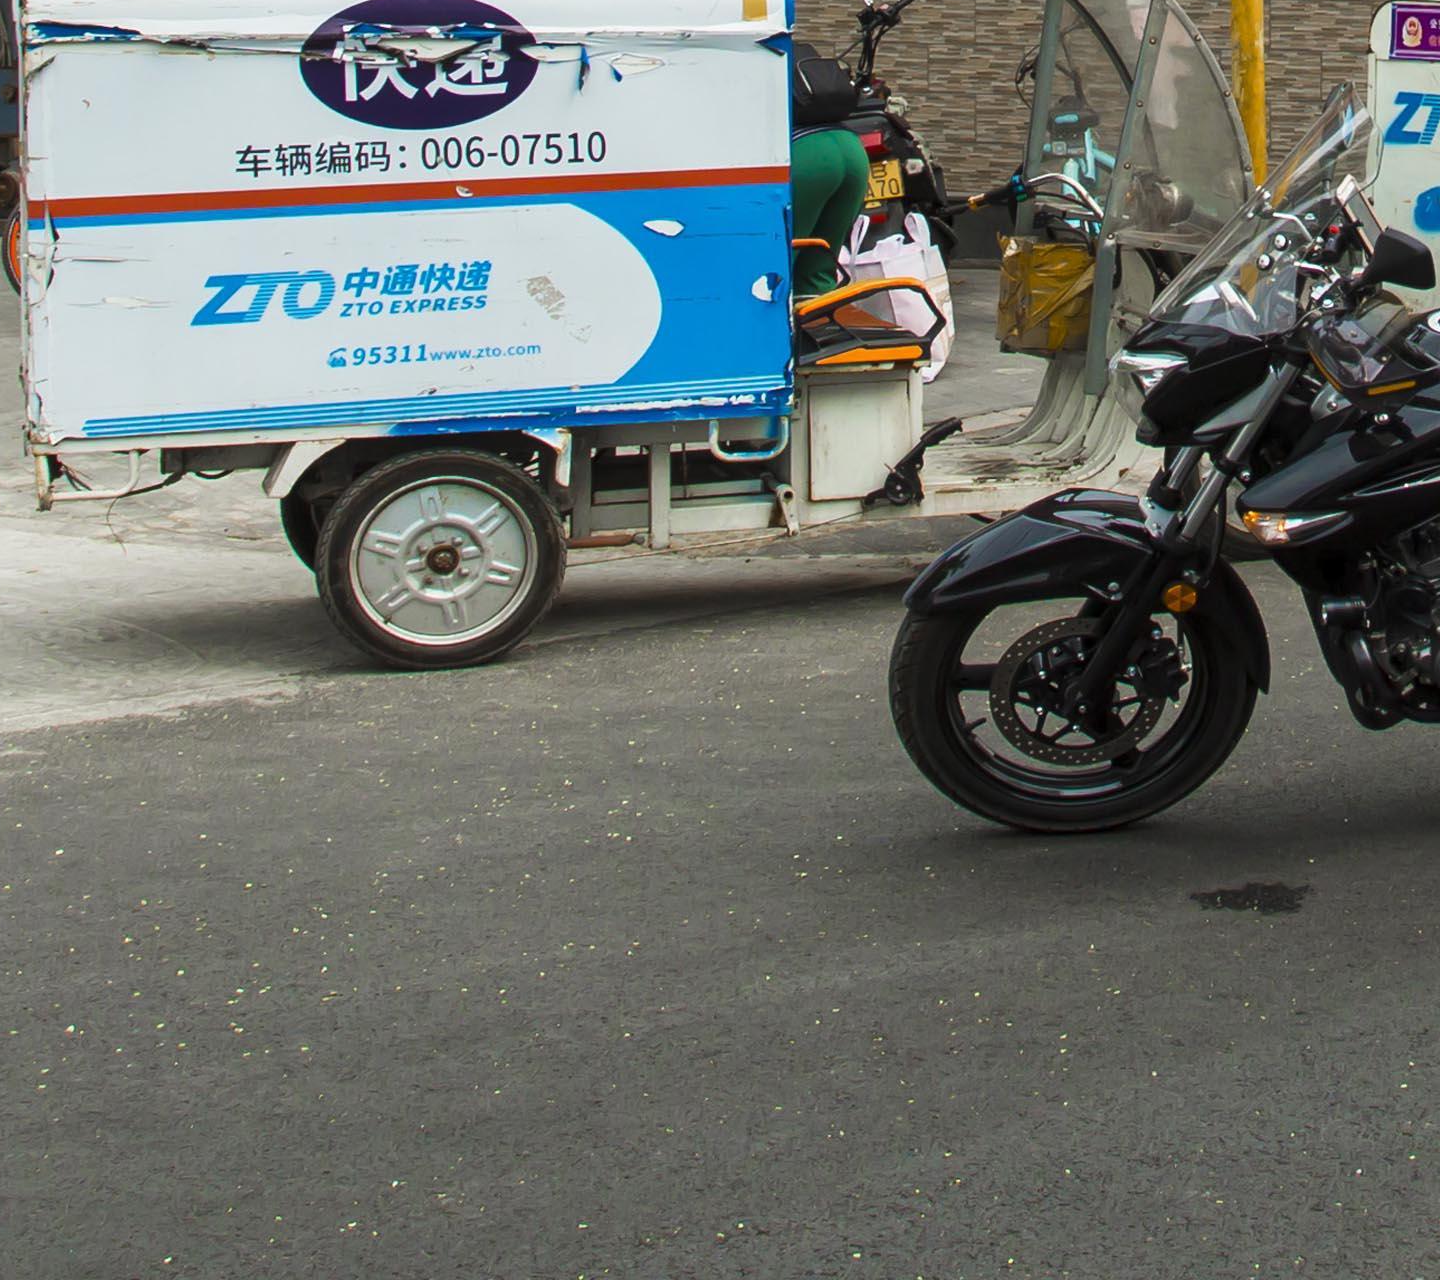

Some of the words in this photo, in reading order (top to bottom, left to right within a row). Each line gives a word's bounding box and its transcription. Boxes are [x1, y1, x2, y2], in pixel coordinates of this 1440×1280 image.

[343, 260, 492, 298] 中通快递
[192, 269, 336, 327] ZTO
[339, 300, 383, 318] ZTO
[389, 295, 488, 314] EXPRESS
[351, 342, 429, 366] 95311
[429, 340, 542, 362] www.zto.com
